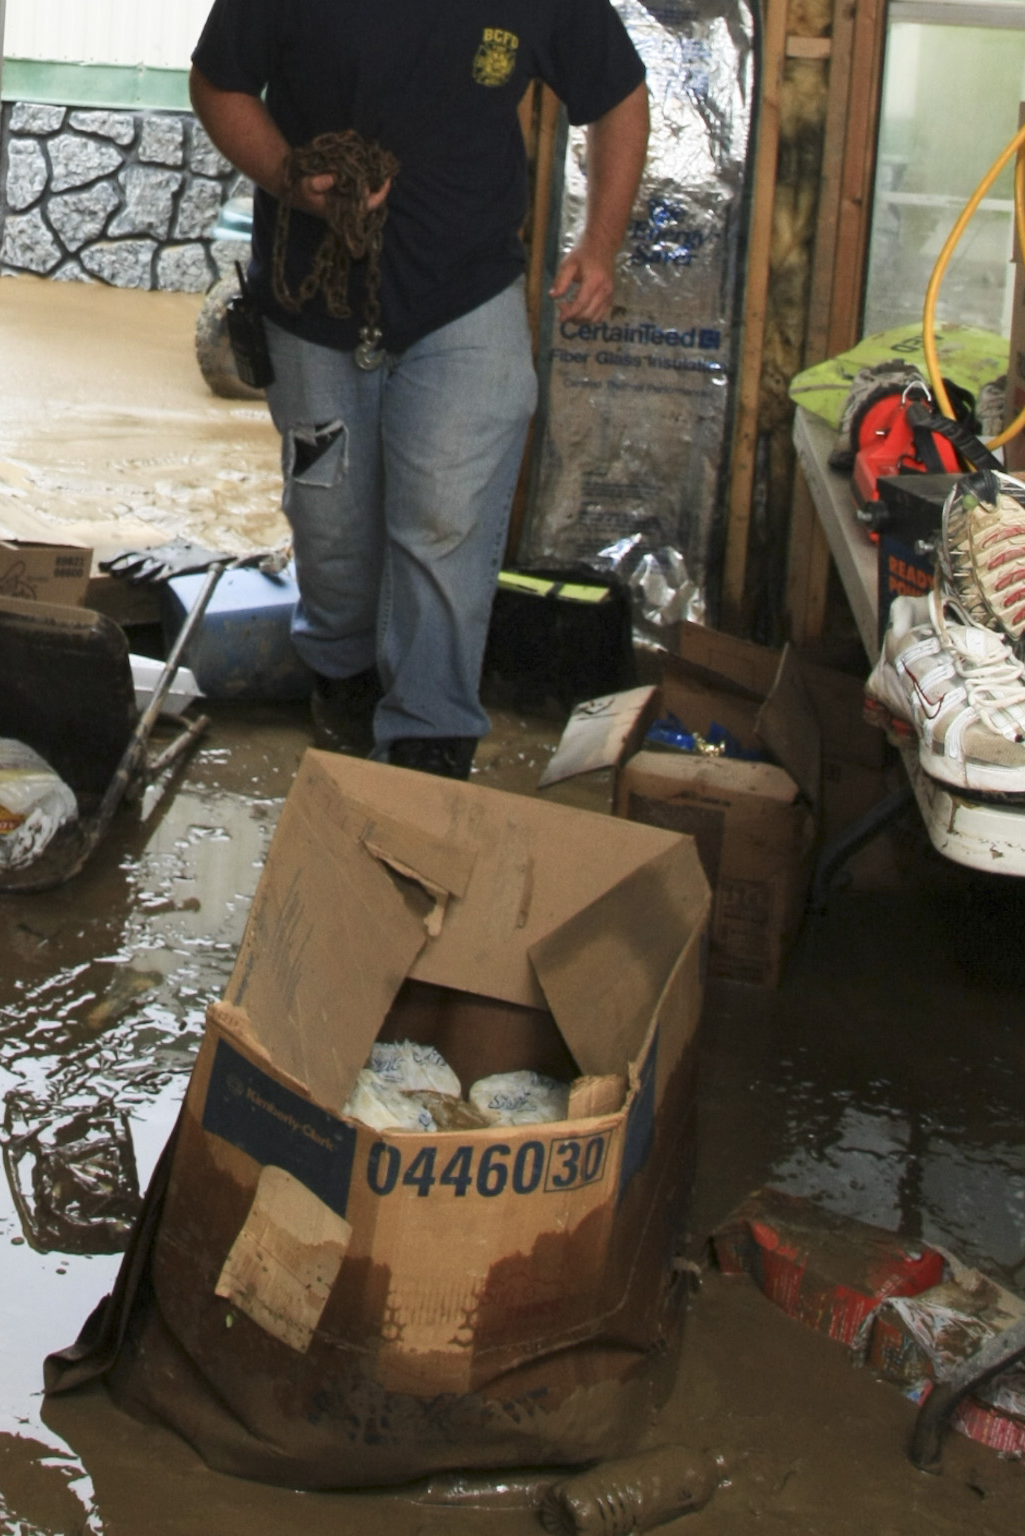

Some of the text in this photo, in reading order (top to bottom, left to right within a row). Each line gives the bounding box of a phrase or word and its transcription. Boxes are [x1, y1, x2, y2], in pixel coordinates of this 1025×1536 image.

[559, 321, 696, 348] CertainTeed
[550, 348, 590, 364] Fiber
[596, 350, 642, 368] Glass
[246, 1087, 335, 1152] Kimberly-Clark
